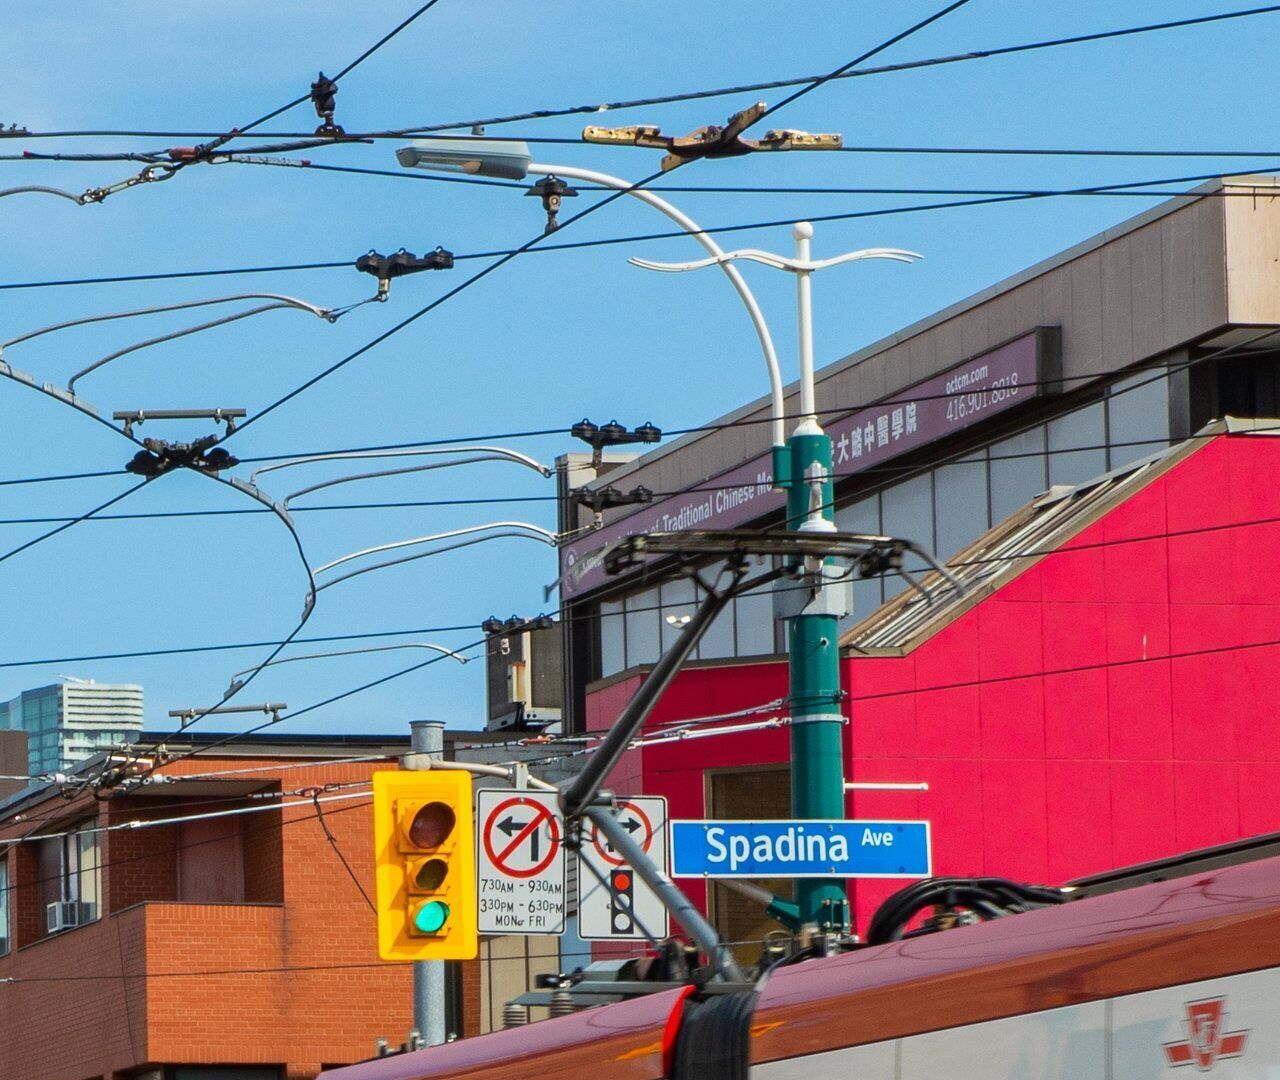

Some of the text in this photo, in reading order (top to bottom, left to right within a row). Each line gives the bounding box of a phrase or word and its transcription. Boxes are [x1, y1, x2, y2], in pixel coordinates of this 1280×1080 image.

[945, 372, 1019, 423] 416.901.8818
[946, 364, 989, 394] octcm.com
[829, 402, 918, 467] 大略中醫學院
[662, 500, 713, 533] Traditional
[715, 484, 755, 514] Chinese
[706, 827, 893, 871] Spadina Ave
[529, 916, 546, 927] FRI
